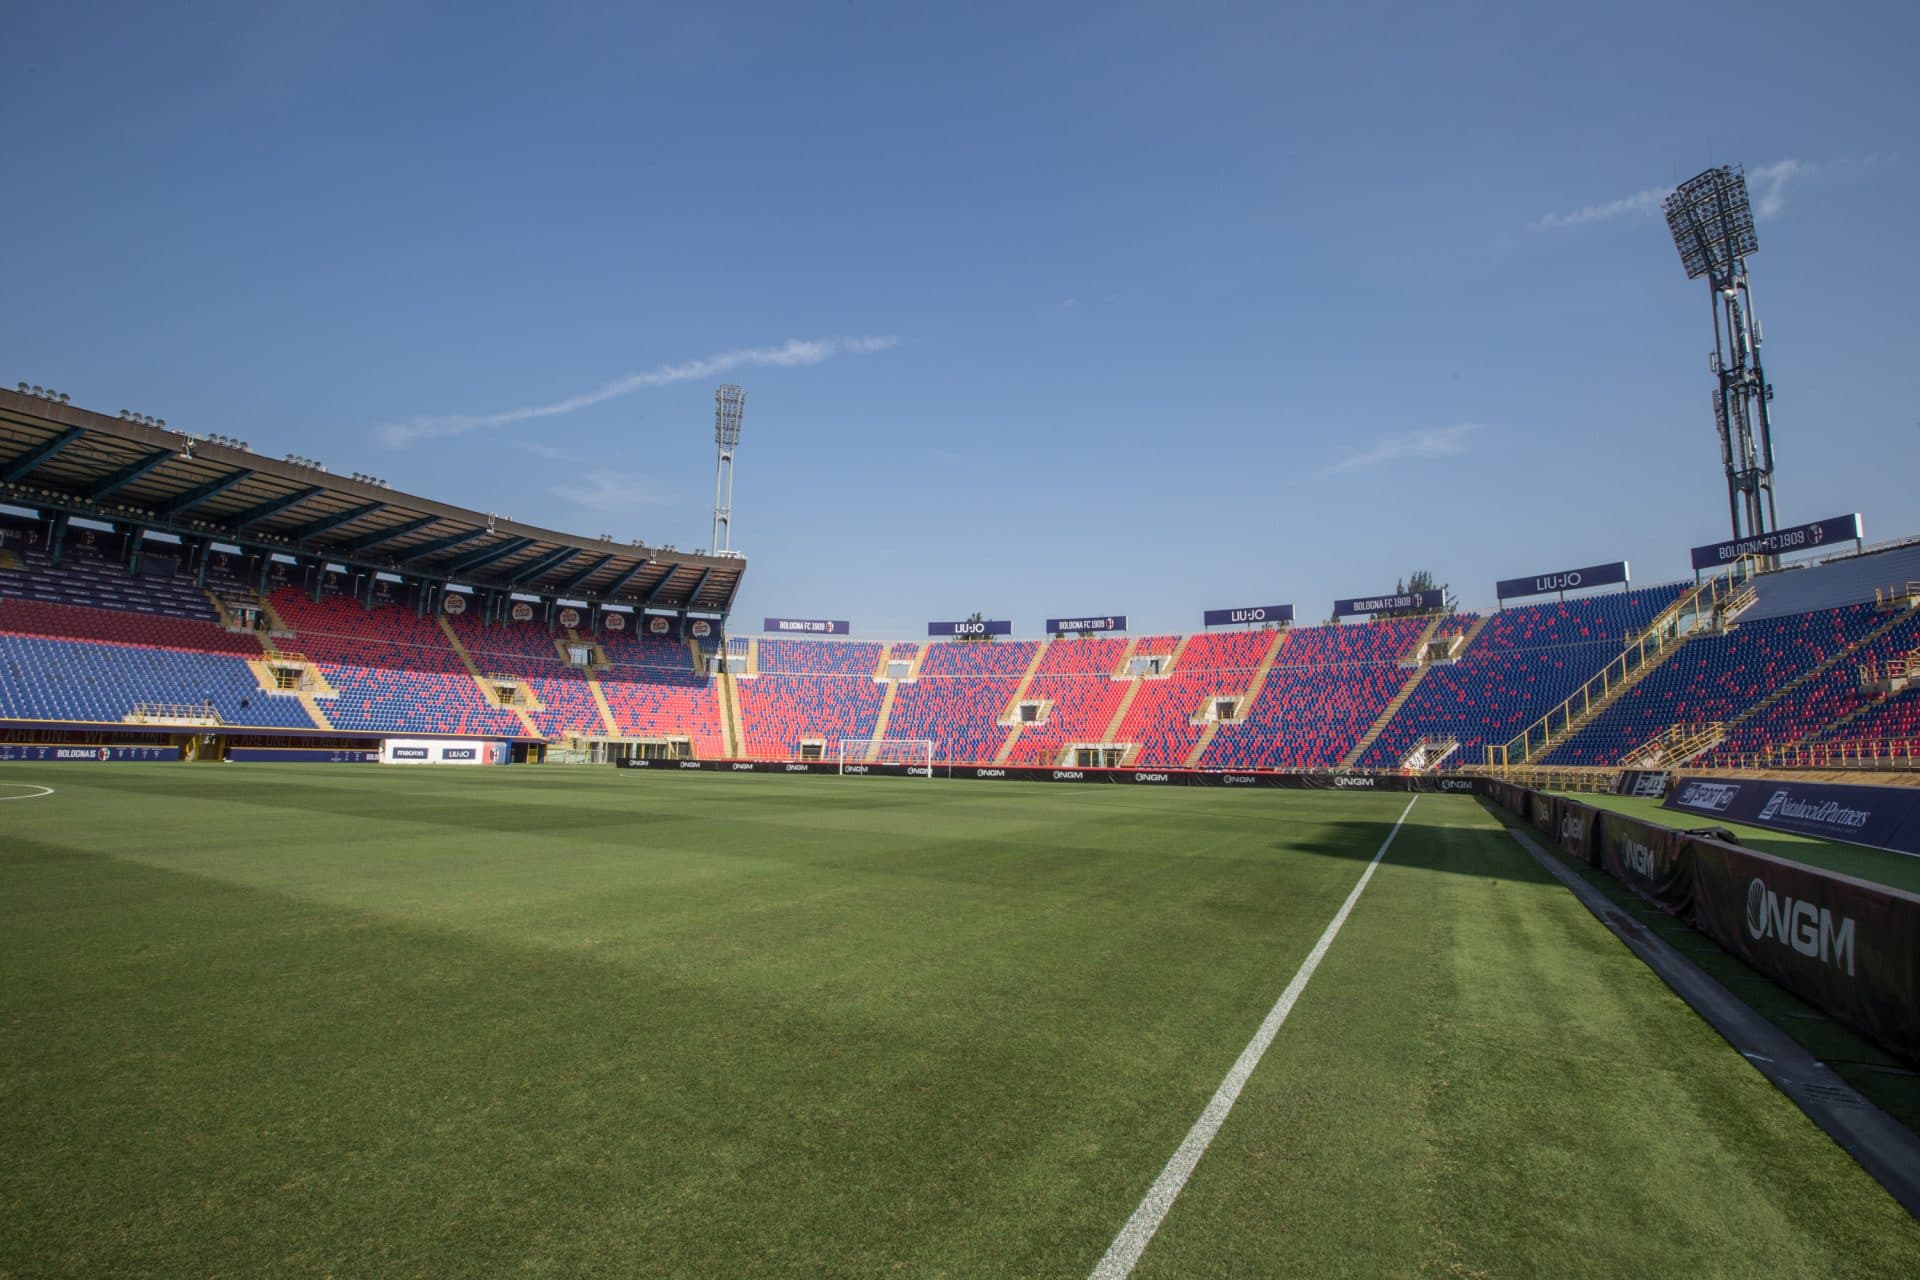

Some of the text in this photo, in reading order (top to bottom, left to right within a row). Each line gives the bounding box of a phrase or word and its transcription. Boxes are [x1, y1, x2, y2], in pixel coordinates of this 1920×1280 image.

[1719, 540, 1762, 560] BOLOGNA
[1779, 530, 1805, 548] 1909
[1353, 596, 1411, 611] BOLOGNA FC 1909
[779, 621, 803, 630] BOLOGNA
[1059, 620, 1083, 630] BOLOGNA
[1084, 620, 1091, 629] FC
[57, 749, 89, 758] BOLOGNA
